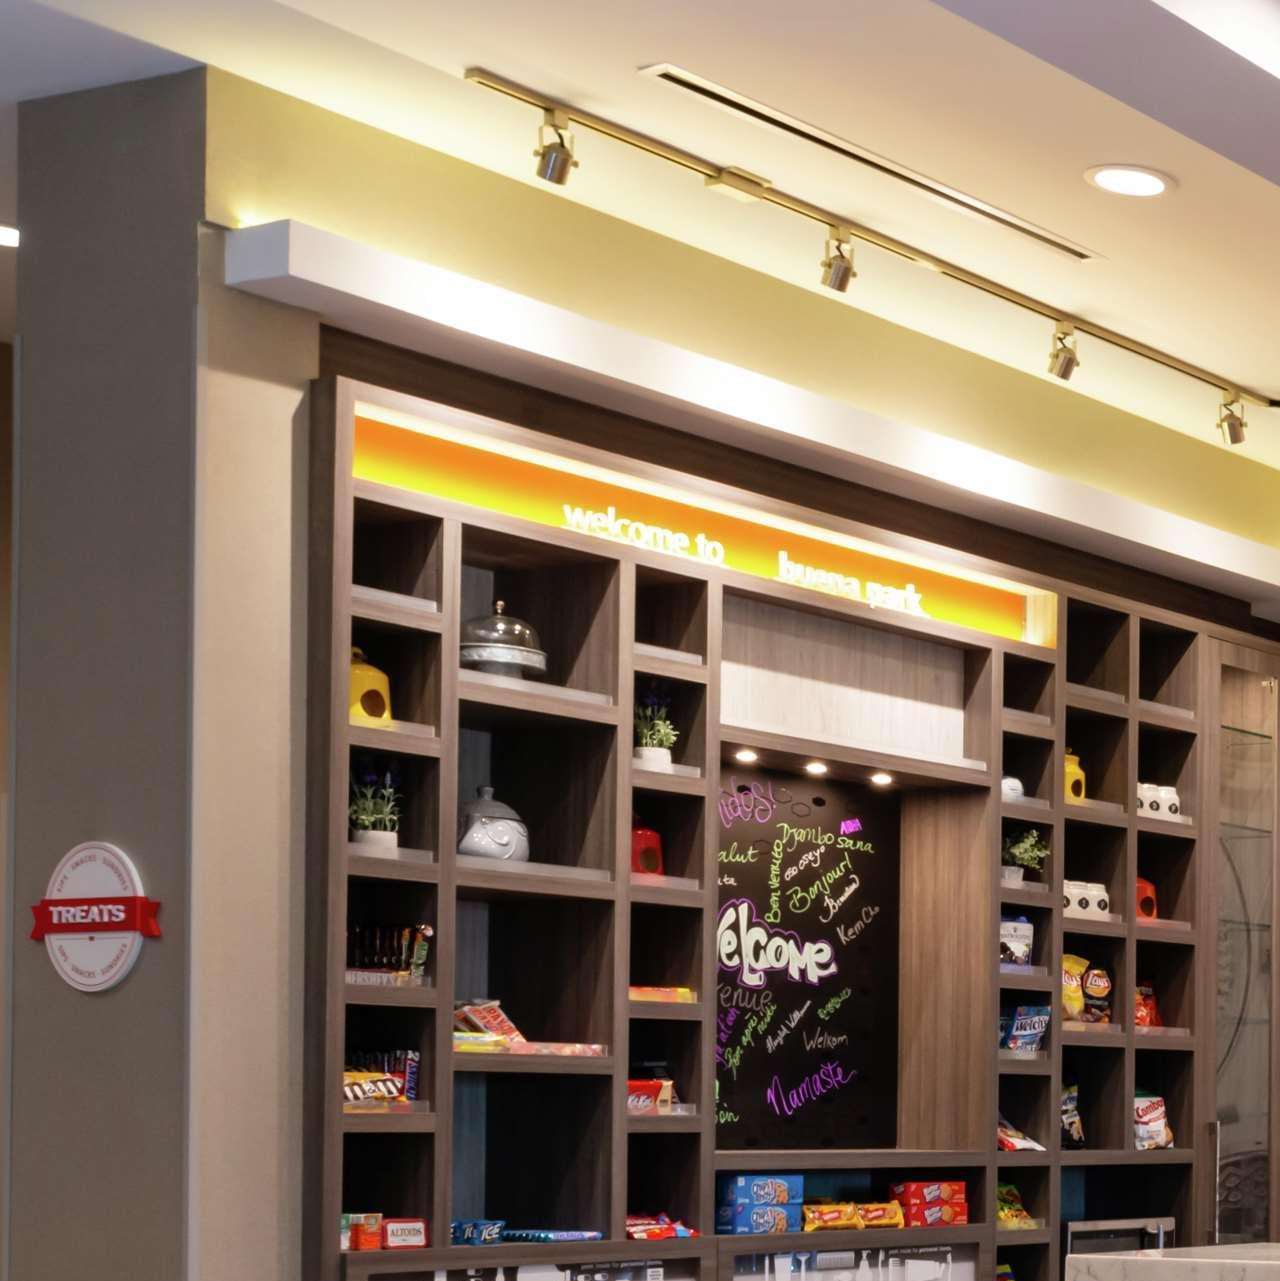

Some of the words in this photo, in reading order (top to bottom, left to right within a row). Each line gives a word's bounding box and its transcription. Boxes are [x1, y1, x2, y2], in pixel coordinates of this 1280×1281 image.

[562, 504, 689, 556] welcome
[695, 533, 725, 564] to
[777, 550, 861, 602] buena
[866, 584, 923, 615] park
[718, 842, 759, 863] alut
[48, 904, 126, 924] TREATS
[767, 1061, 857, 1115] Namaste
